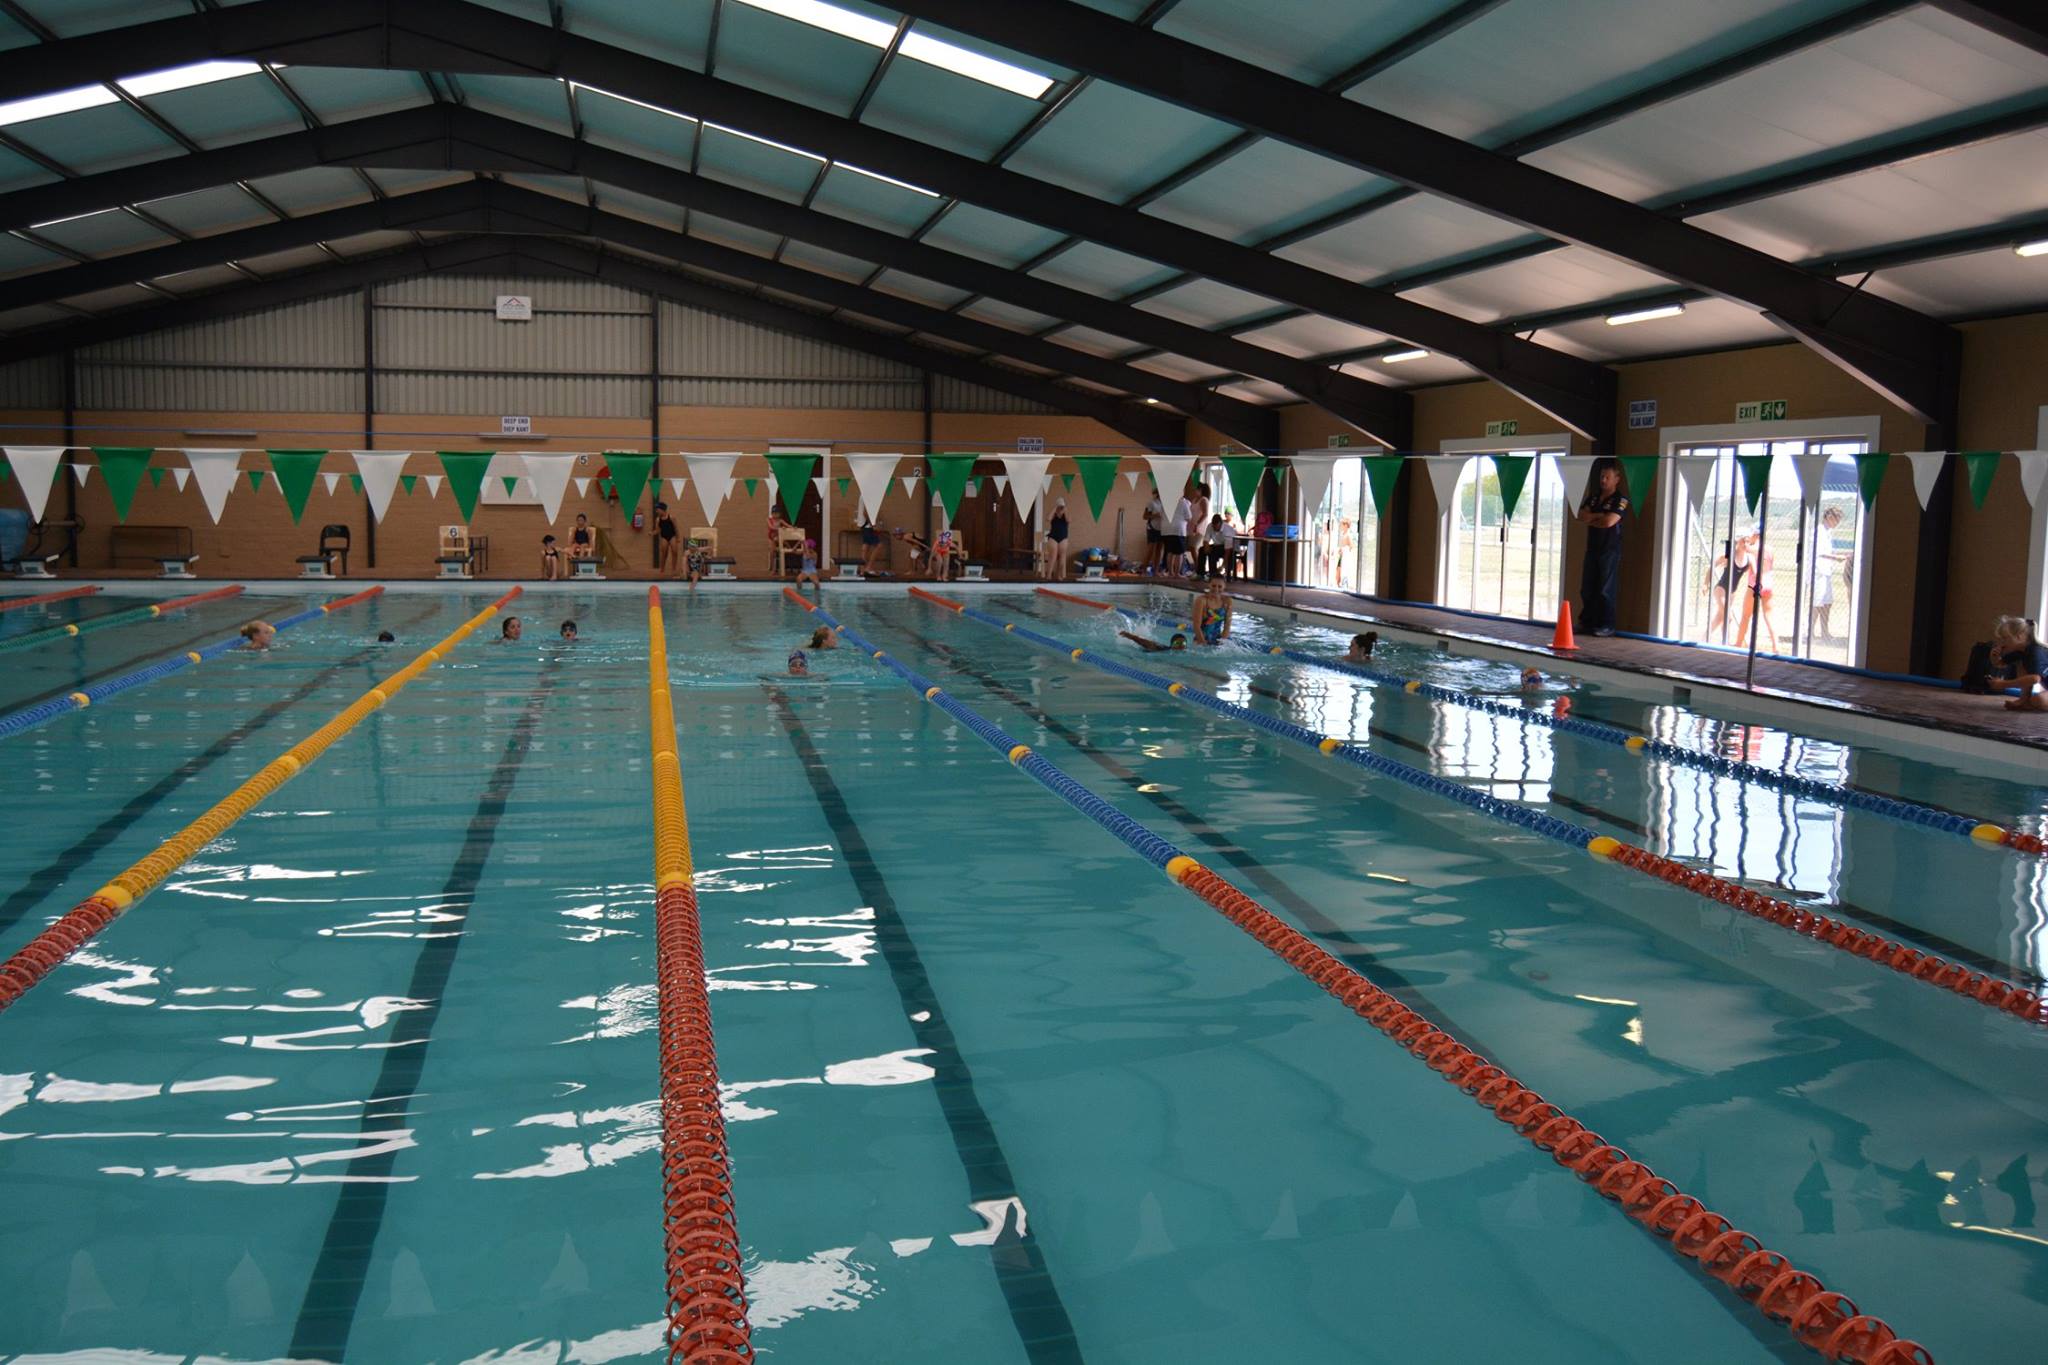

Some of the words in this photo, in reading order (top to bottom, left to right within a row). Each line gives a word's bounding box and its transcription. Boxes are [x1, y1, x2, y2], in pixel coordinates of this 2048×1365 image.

[1739, 406, 1757, 419] EXIT
[1488, 424, 1499, 435] EXIT
[580, 455, 587, 464] 5
